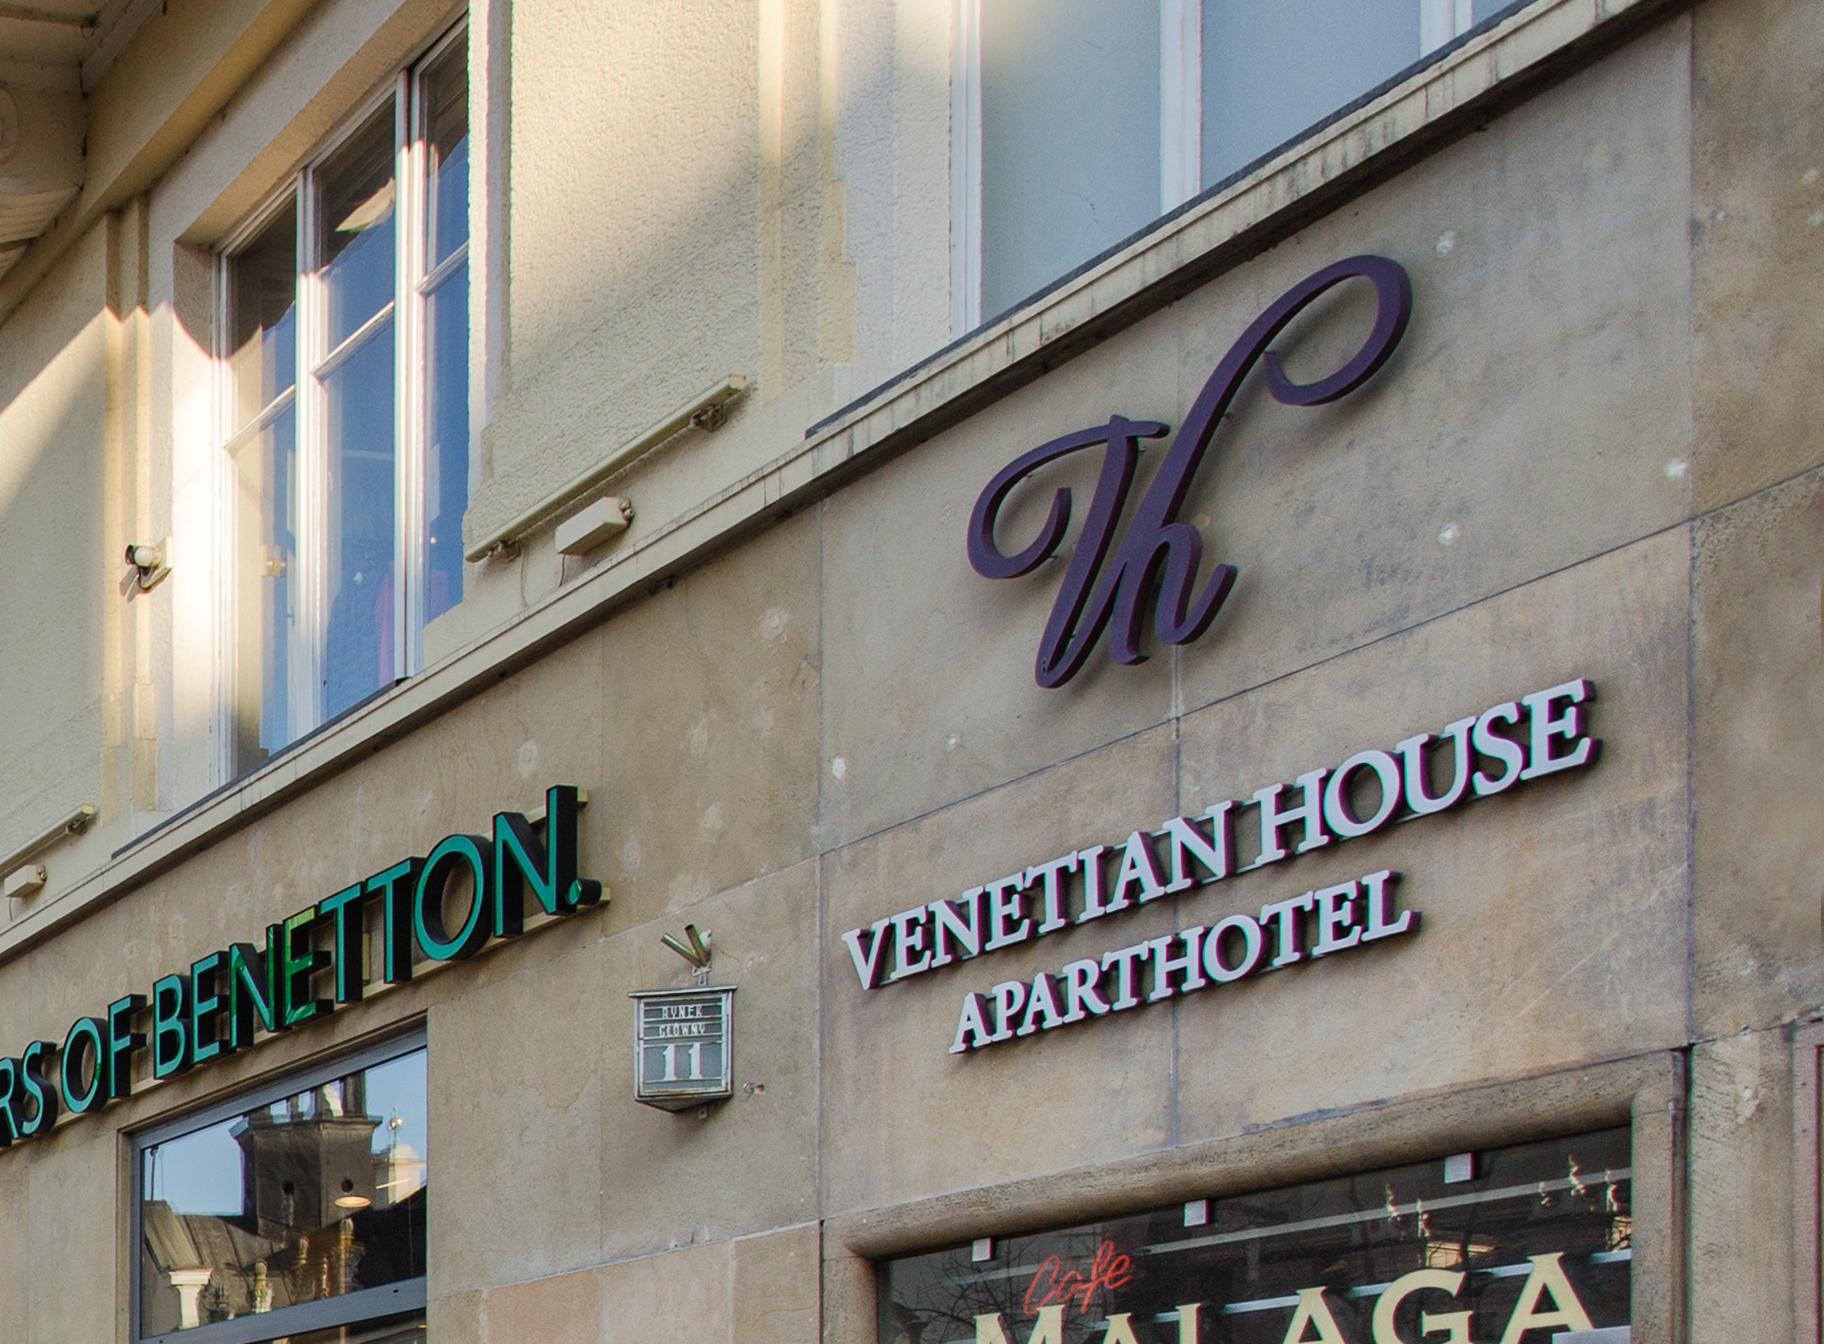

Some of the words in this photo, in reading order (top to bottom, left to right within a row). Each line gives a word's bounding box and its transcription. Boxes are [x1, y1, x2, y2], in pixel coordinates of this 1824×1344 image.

[841, 799, 1241, 990] VENETIAN
[1253, 678, 1597, 865] HOUSE
[948, 868, 1421, 1054] APARTHOTEL
[61, 994, 146, 1114] OF
[662, 1005, 703, 1018] RYNEK
[663, 1042, 704, 1081] 11
[1023, 1240, 1133, 1317] Cafe
